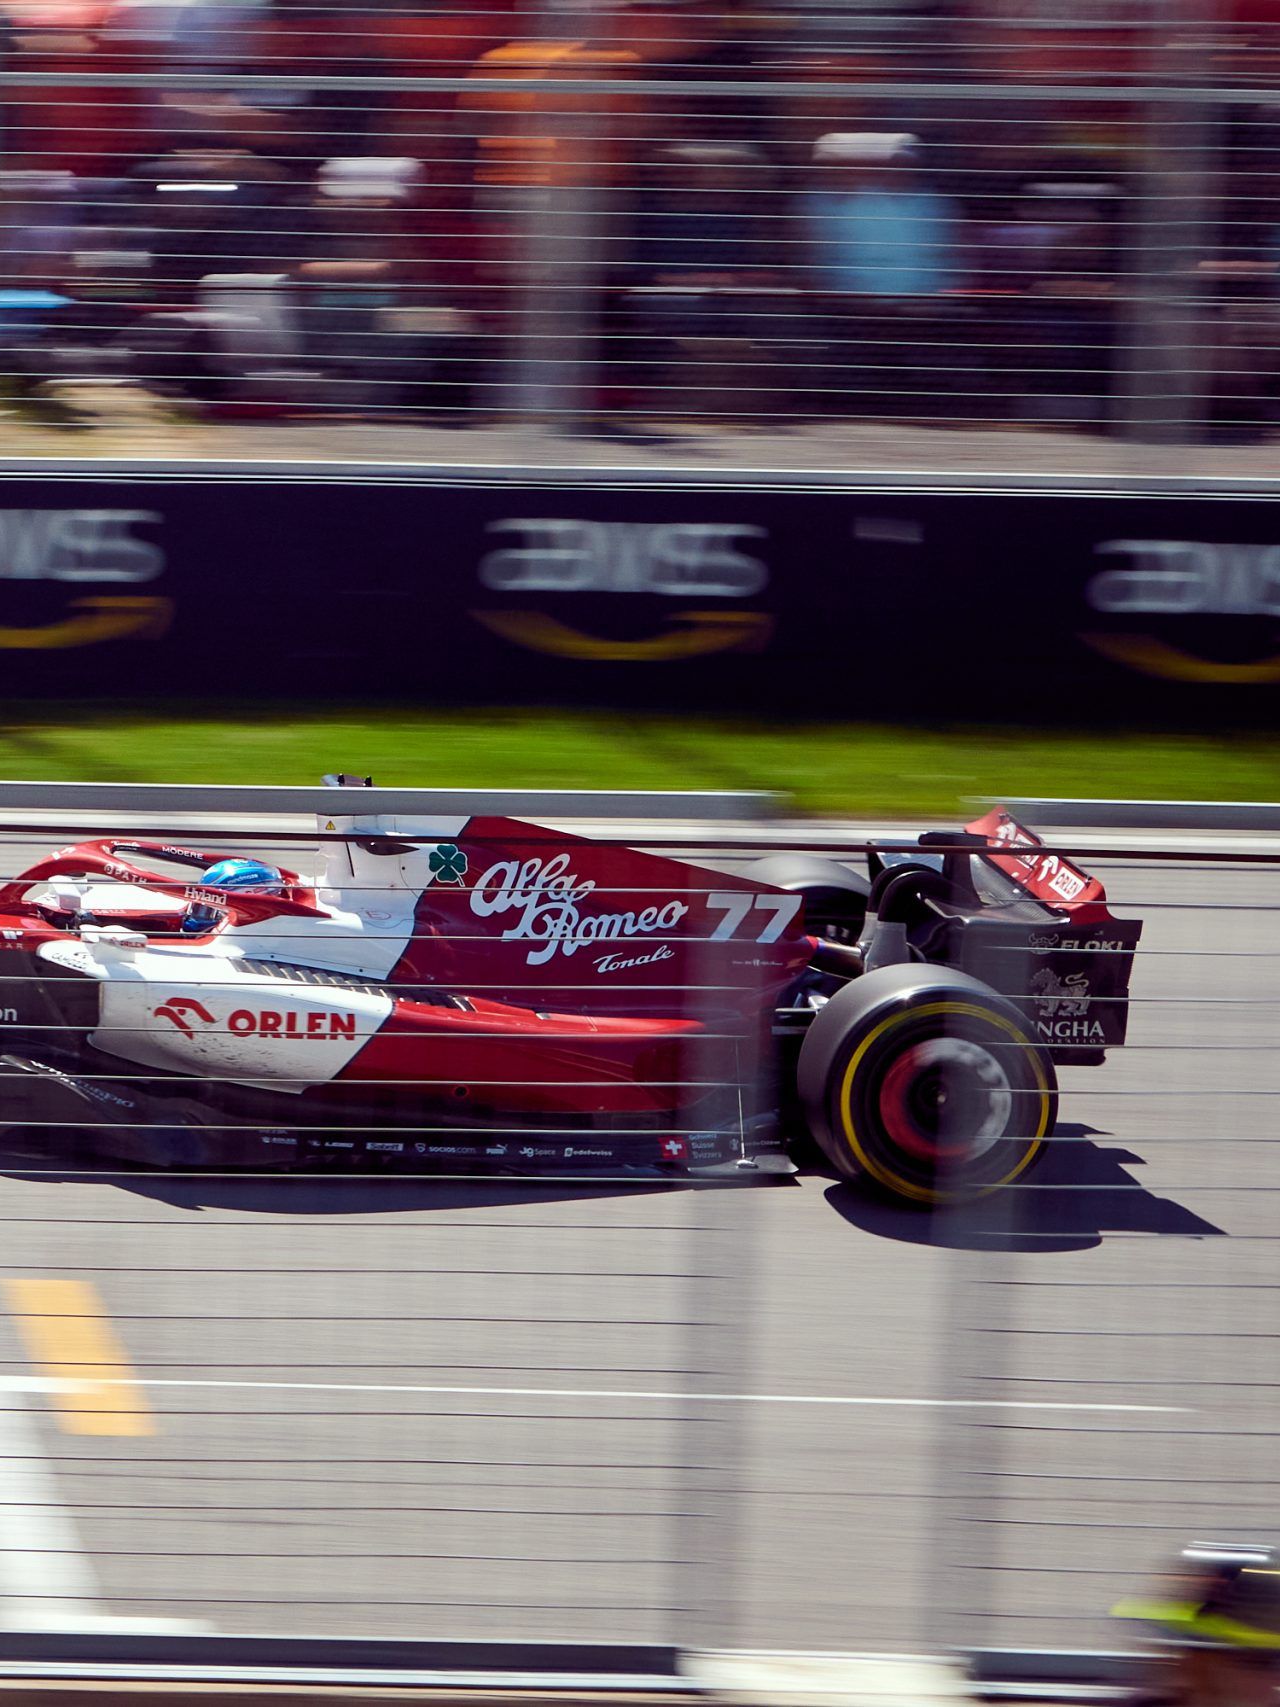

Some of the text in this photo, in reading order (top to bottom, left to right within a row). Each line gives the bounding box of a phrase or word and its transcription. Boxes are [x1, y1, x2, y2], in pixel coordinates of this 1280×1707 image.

[477, 518, 769, 597] aws
[469, 853, 596, 942] Alfa
[705, 892, 804, 944] 77
[525, 899, 689, 966] Romeo
[592, 944, 675, 974] Tonale
[227, 1009, 356, 1041] ORLEN
[1032, 1020, 1105, 1037] NGHA
